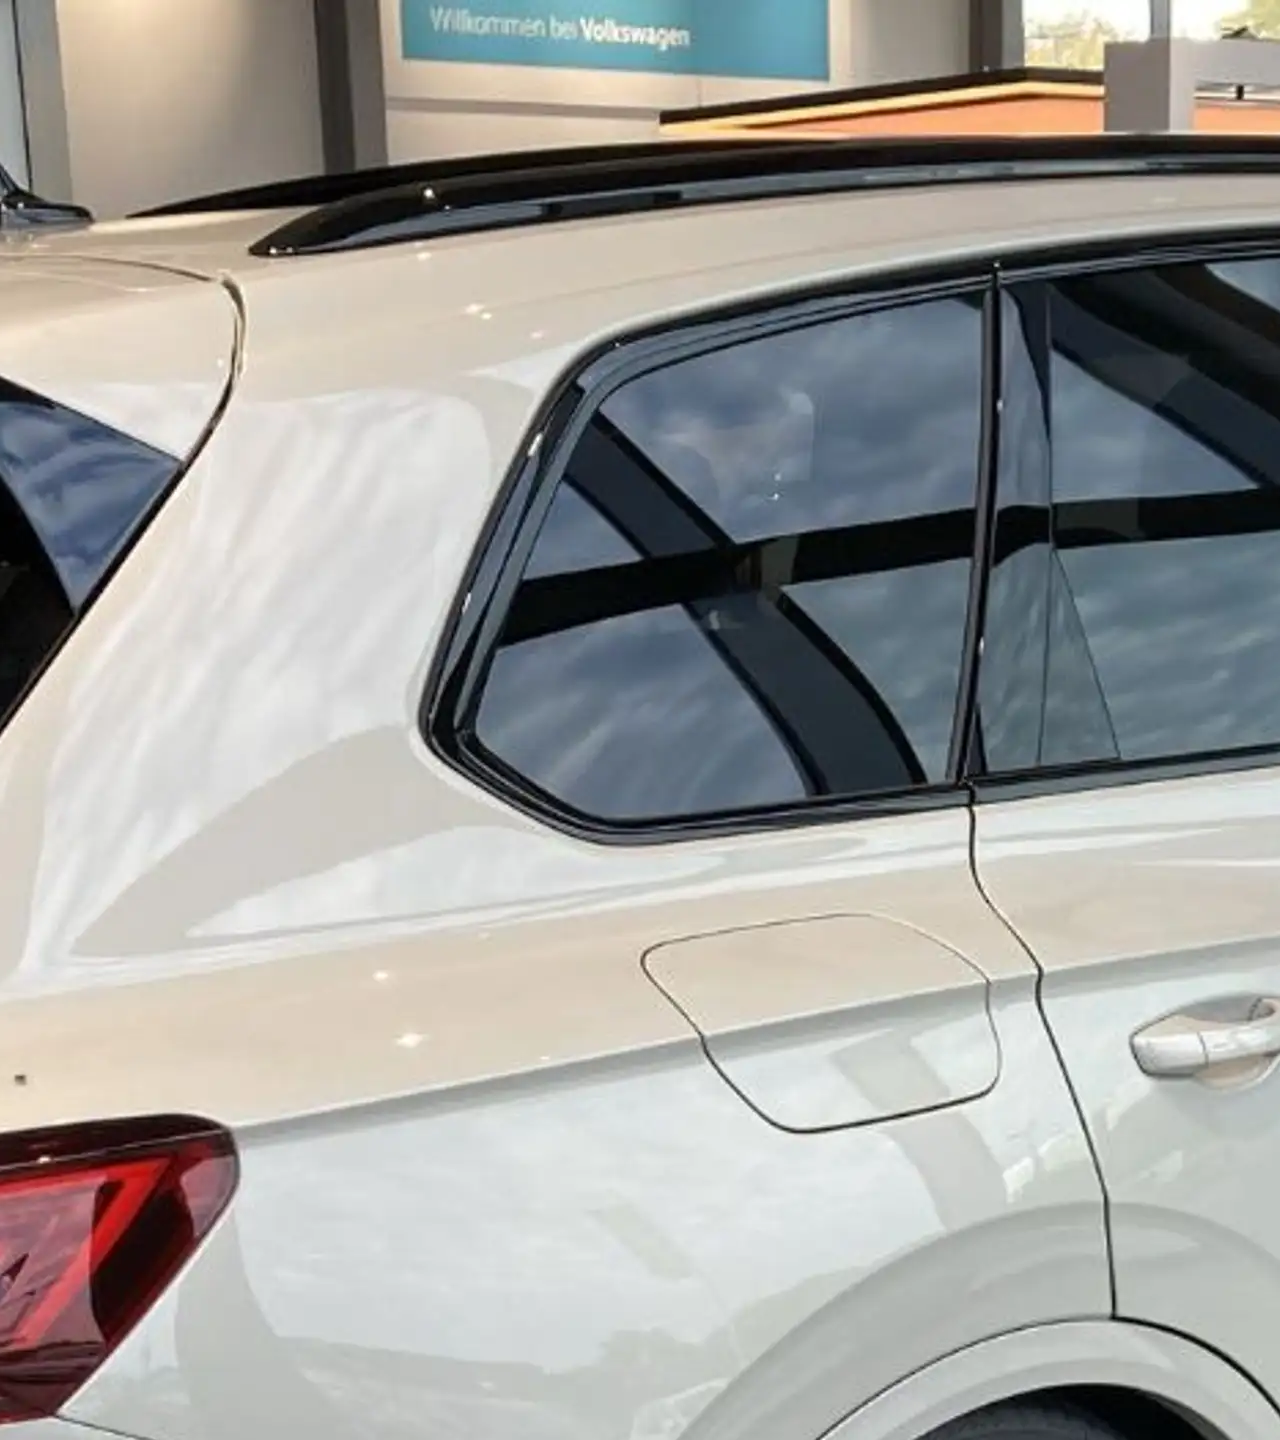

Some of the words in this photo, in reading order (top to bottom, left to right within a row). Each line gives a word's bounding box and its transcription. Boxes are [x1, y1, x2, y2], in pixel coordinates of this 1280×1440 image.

[429, 7, 546, 38] Willkommen
[550, 14, 577, 40] bei
[579, 16, 691, 51] Volkswagen
